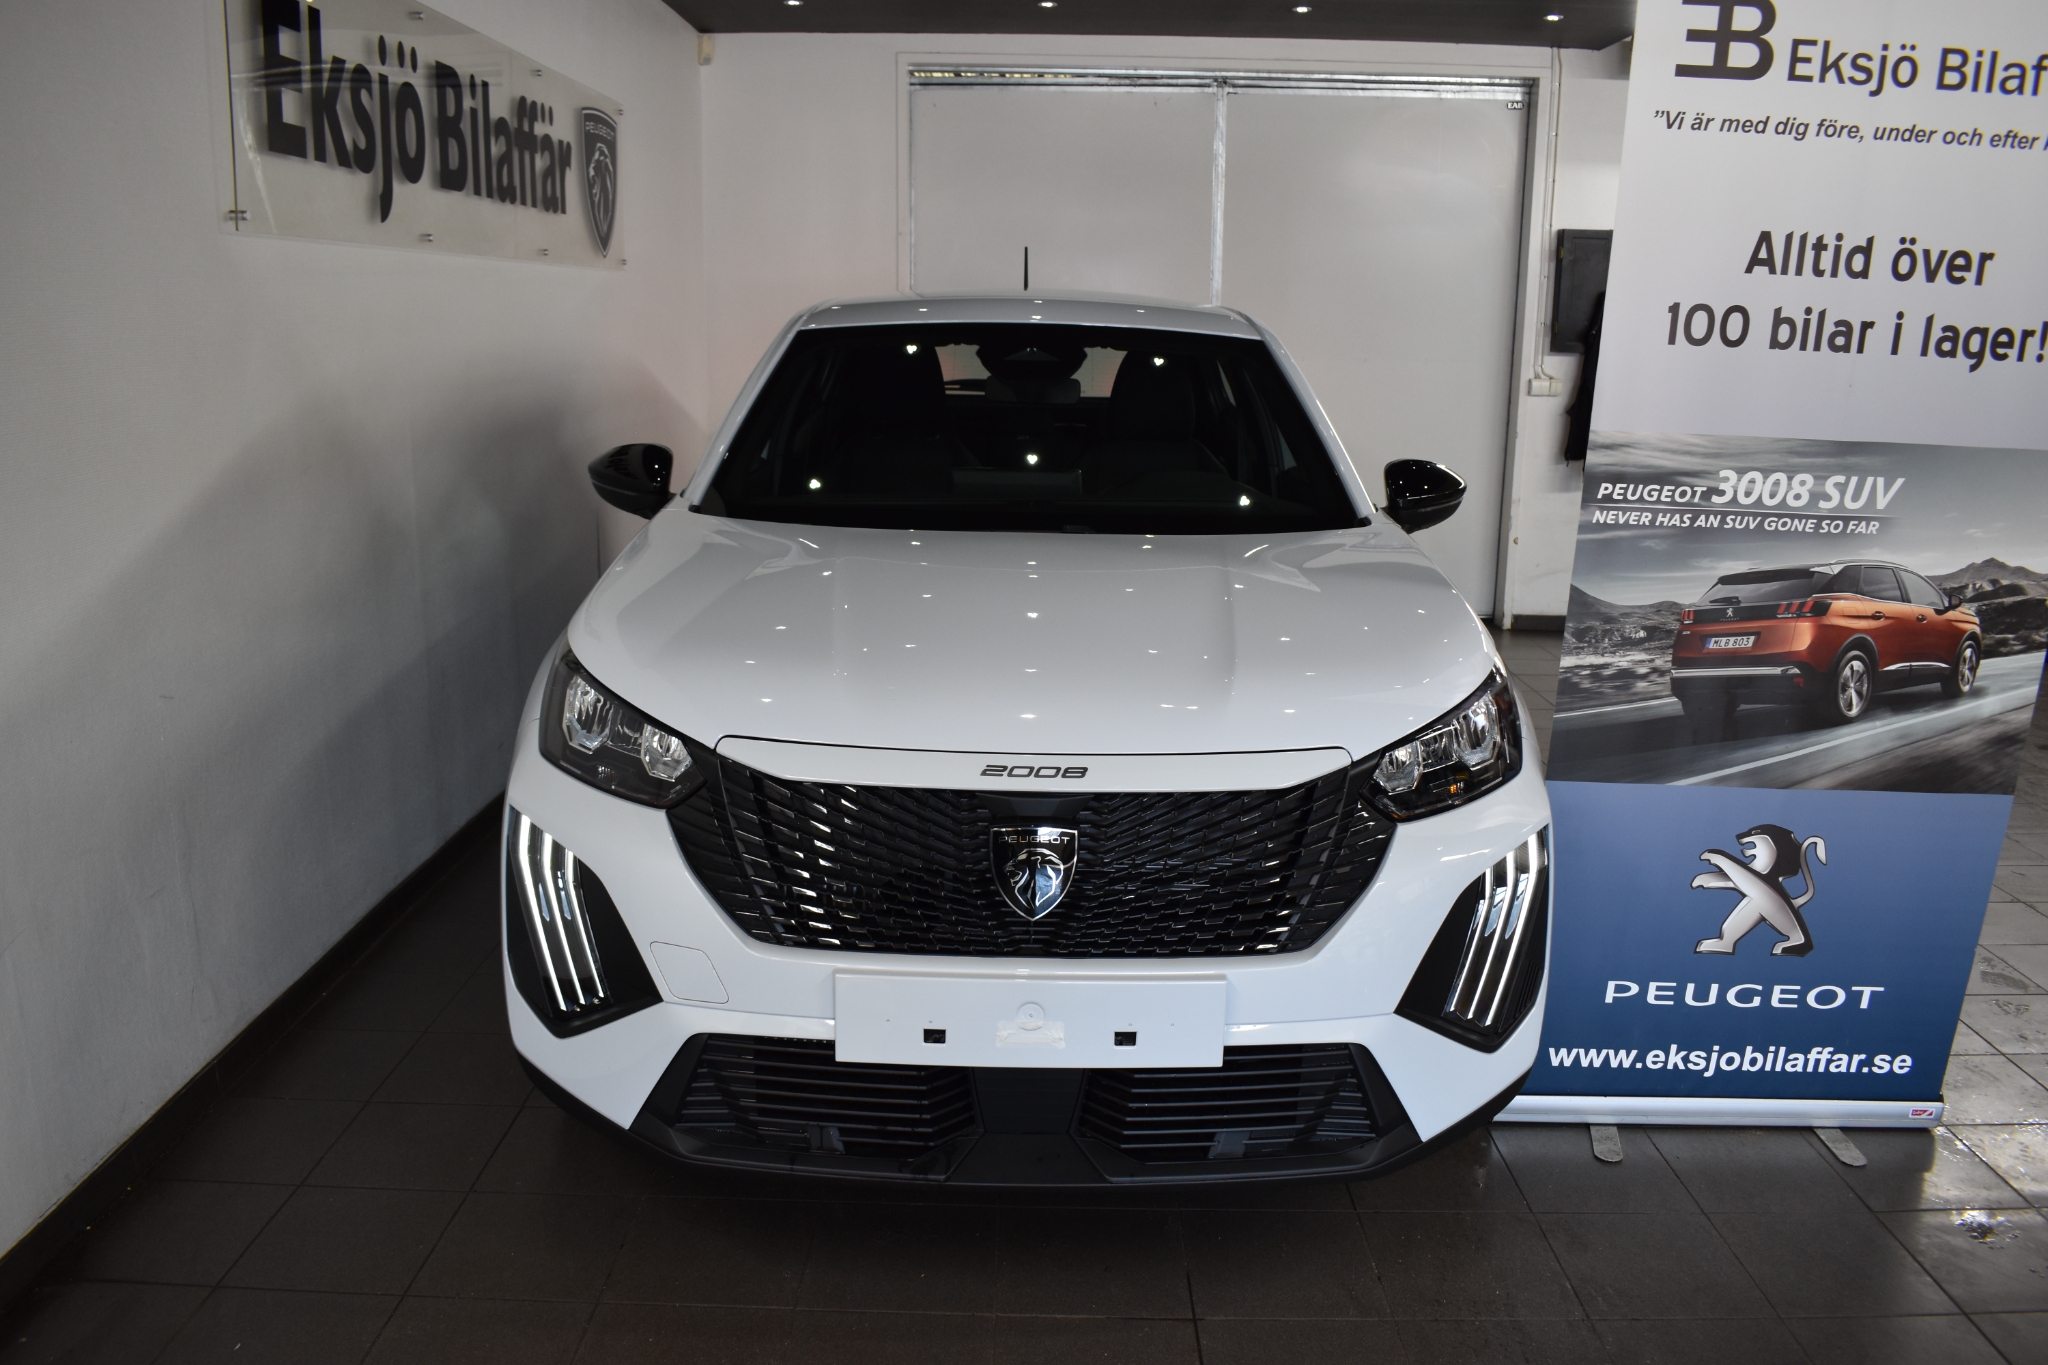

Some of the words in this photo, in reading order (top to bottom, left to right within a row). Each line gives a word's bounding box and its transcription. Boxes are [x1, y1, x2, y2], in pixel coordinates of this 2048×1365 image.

[1786, 38, 1919, 97] Eksjö
[262, 0, 427, 224] Eksjö
[435, 60, 573, 215] Bilaffär
[1690, 112, 1715, 132] är
[1719, 116, 1770, 134] med
[1774, 117, 1810, 141] dig
[1815, 118, 1864, 143] före,
[1873, 124, 1938, 144] under
[1942, 128, 1984, 146] och
[1989, 130, 2040, 150] efter
[1744, 230, 1875, 280] Alltid
[1891, 236, 1996, 286] över
[1667, 302, 1751, 349] 100
[1768, 306, 1876, 355] bilar
[1890, 311, 1905, 356] i
[1920, 313, 2048, 373] lager!
[1596, 482, 1708, 503] PEUGEOT
[1710, 469, 1815, 508] 3008
[1817, 475, 1906, 510] SUV
[1592, 510, 1653, 526] NEVER
[1655, 512, 1693, 528] HAS
[1693, 514, 1722, 528] AN
[1723, 515, 1762, 530] SUV
[1763, 517, 1818, 533] GONE
[1819, 520, 1844, 534] SO
[1846, 521, 1880, 535] FAR
[1712, 638, 1731, 648] MLB
[1731, 637, 1751, 647] 803
[980, 764, 1089, 779] 2008
[998, 834, 1070, 844] PEUGEOT
[1604, 980, 1885, 1010] PEUGEOT
[1548, 1043, 1913, 1077] www.eksjobilaffar.se
